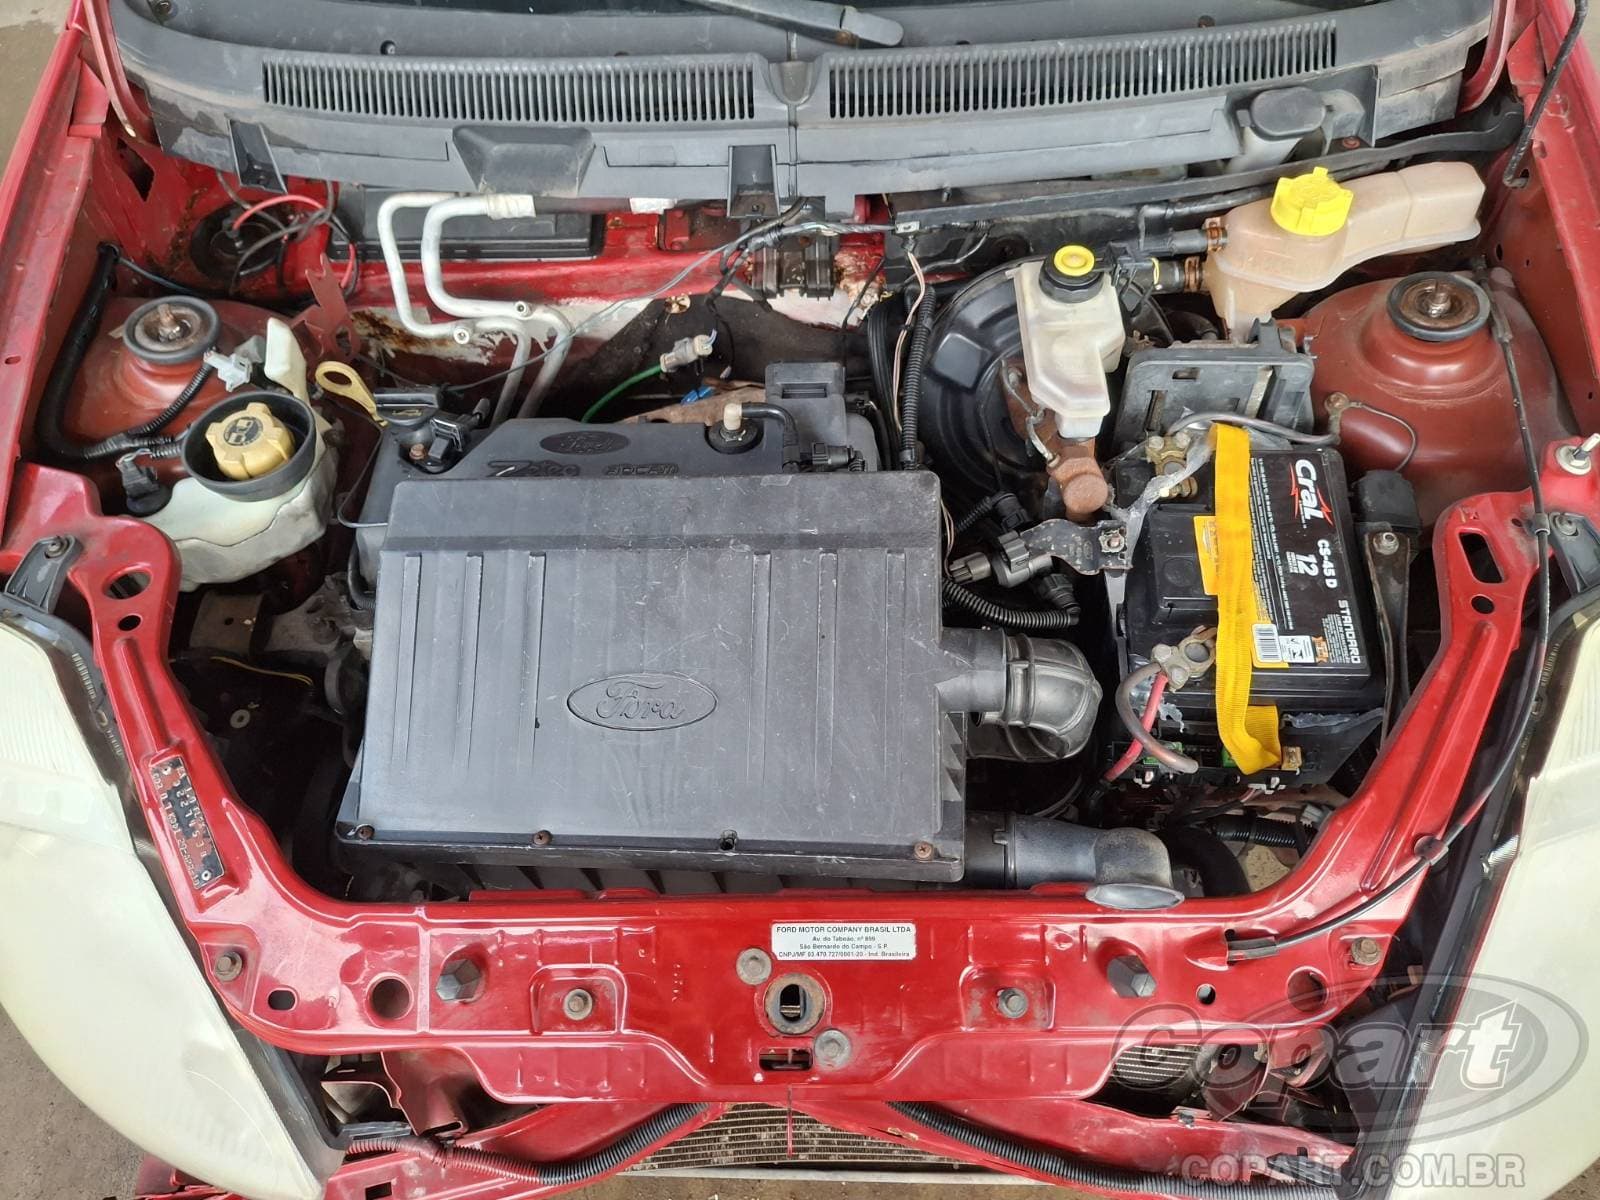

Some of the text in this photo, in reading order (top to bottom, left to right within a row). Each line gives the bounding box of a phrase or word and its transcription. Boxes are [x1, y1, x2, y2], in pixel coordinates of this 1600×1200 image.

[1296, 553, 1319, 577] 12
[1317, 539, 1338, 589] CS-45 D
[1338, 599, 1361, 664] STANDARD
